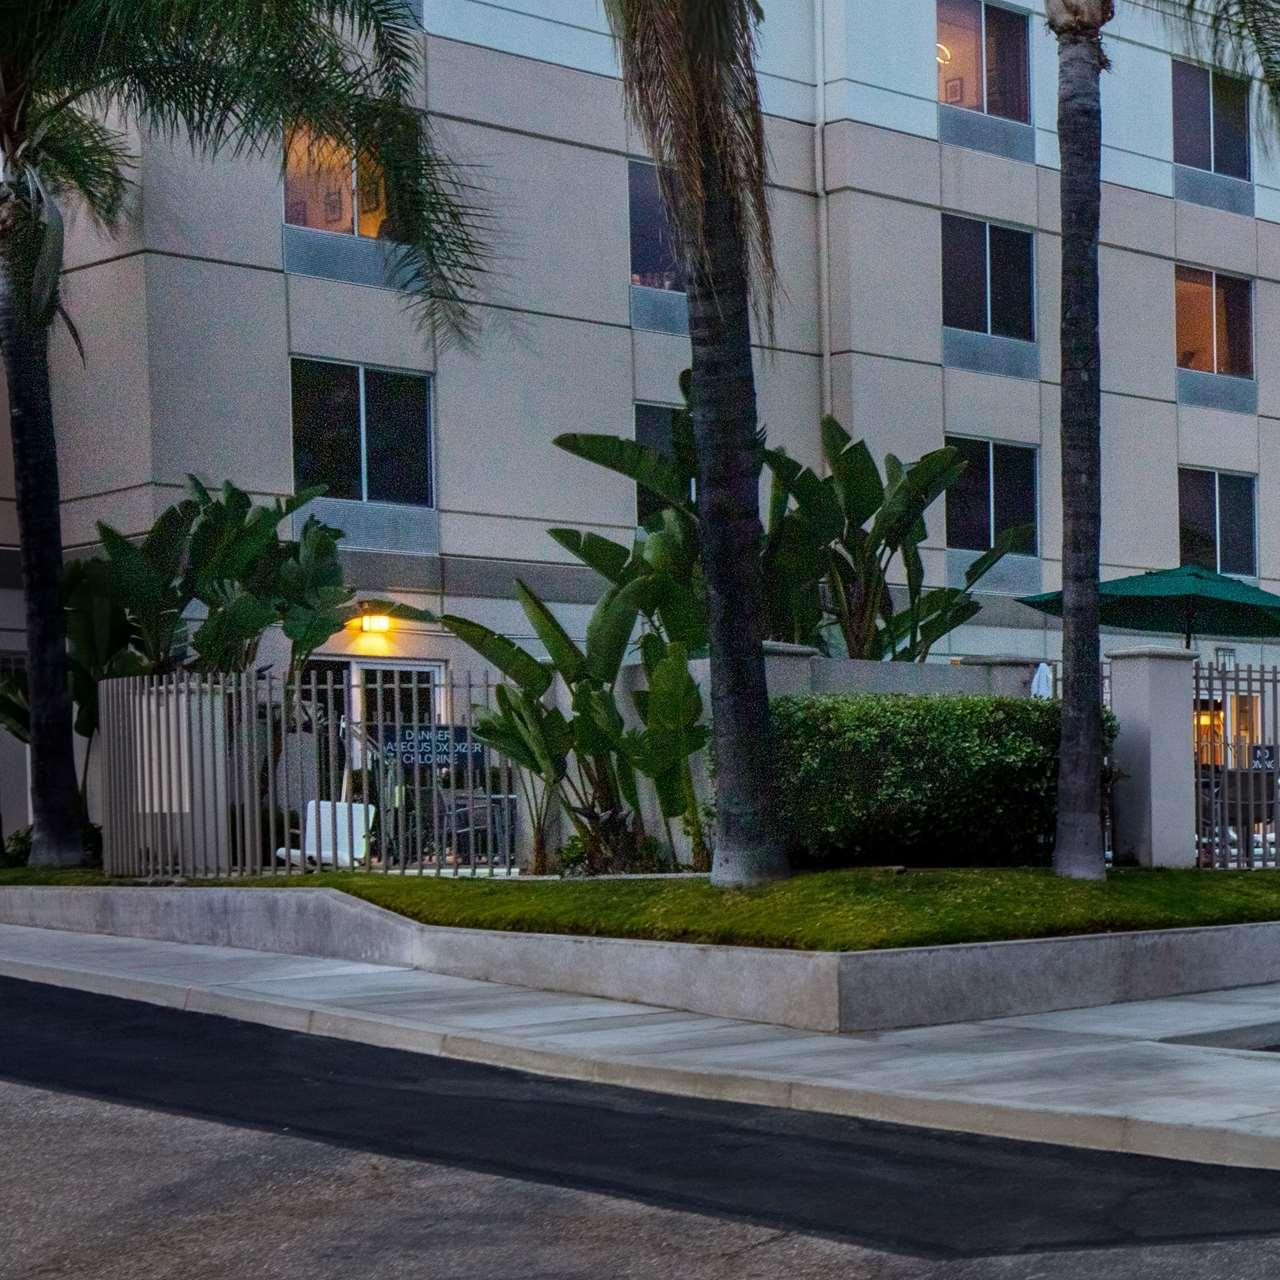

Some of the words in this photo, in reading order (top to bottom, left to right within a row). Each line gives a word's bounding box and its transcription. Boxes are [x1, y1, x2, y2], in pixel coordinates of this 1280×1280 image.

[405, 730, 452, 741] DNER
[379, 742, 432, 753] ASEOUS
[433, 742, 482, 753] OXDIZR
